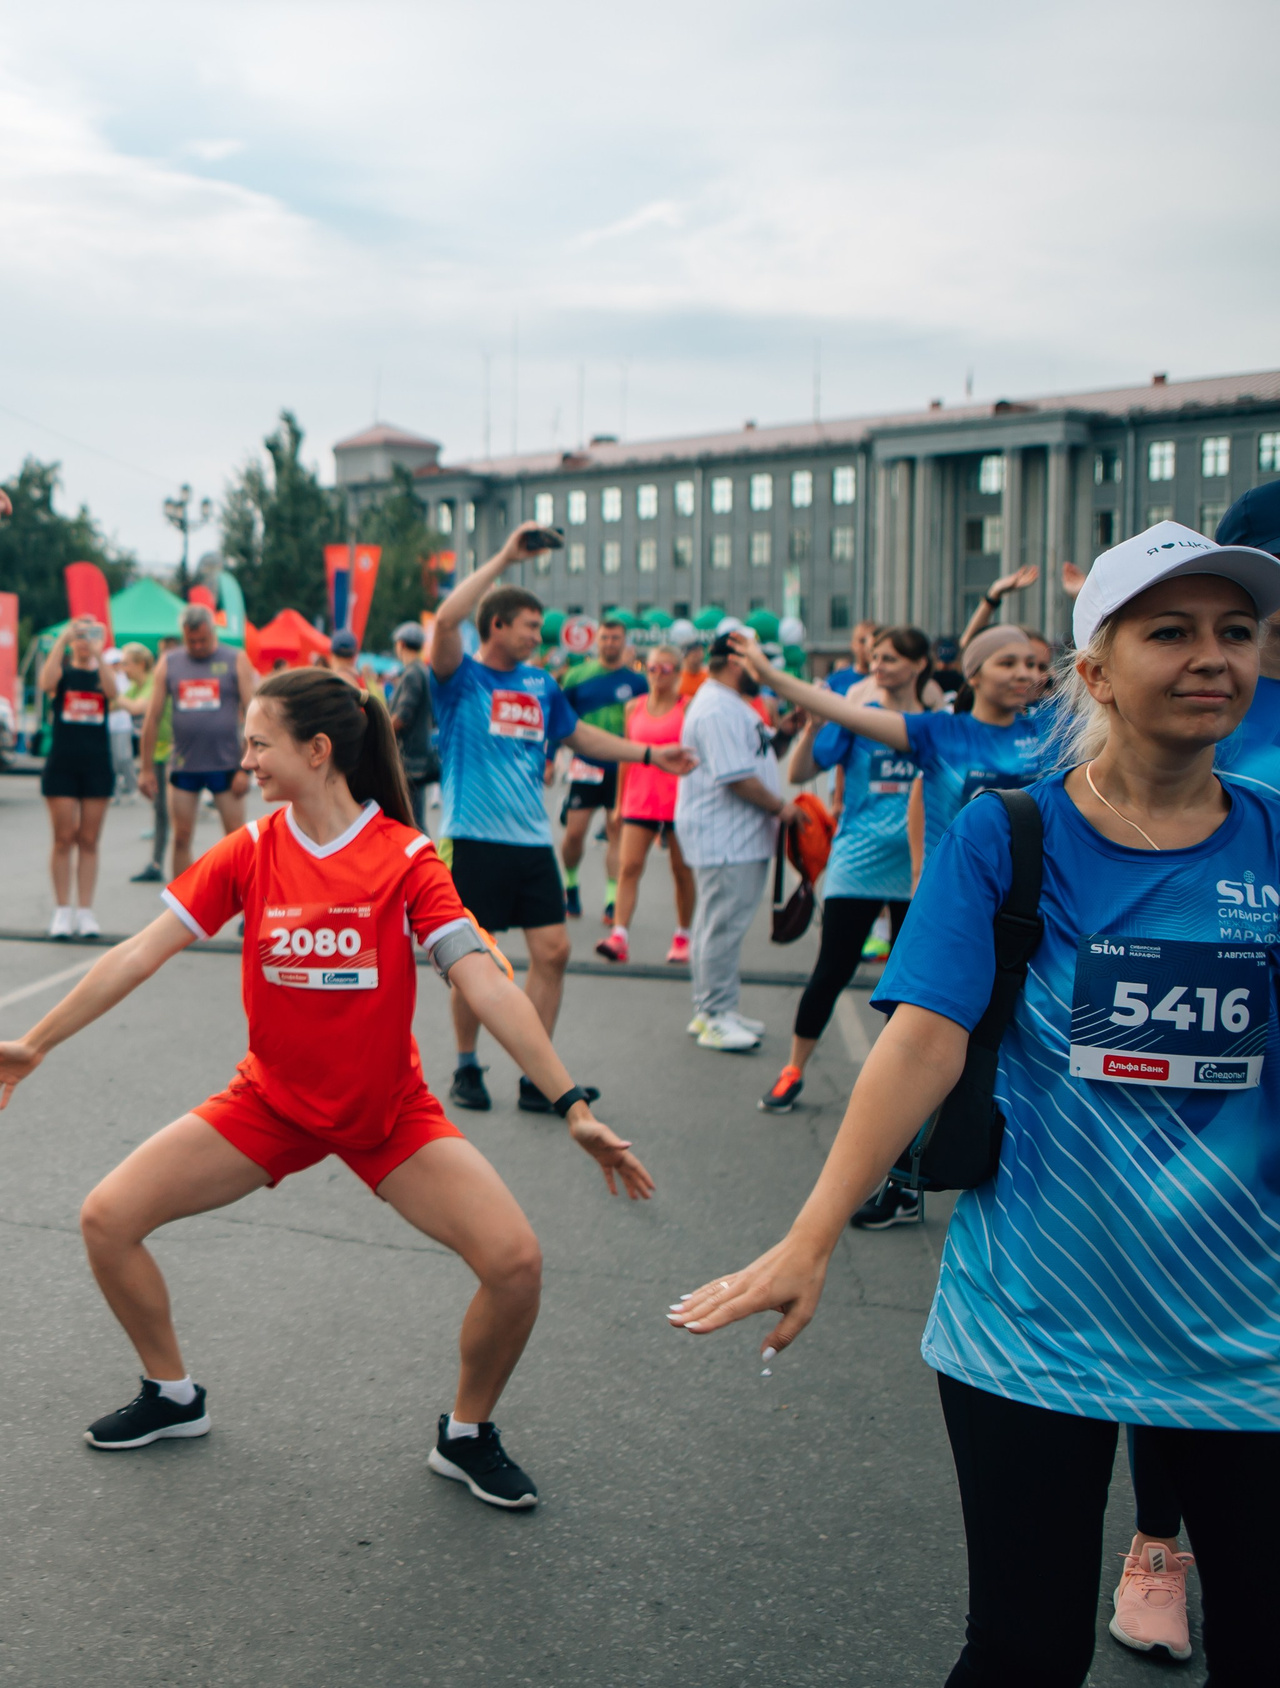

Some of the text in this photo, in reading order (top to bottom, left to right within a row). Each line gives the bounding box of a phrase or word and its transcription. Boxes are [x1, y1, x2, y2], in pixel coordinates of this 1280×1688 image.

[1147, 547, 1159, 556] Я
[880, 759, 915, 778] 541
[270, 928, 362, 957] 2080
[1129, 951, 1161, 959] МАРАФОН
[1224, 951, 1255, 959] АВГУСТА
[1109, 981, 1251, 1034] 5416
[1108, 1060, 1164, 1073] Альфа Банк
[1205, 1069, 1246, 1080] Следопыт
